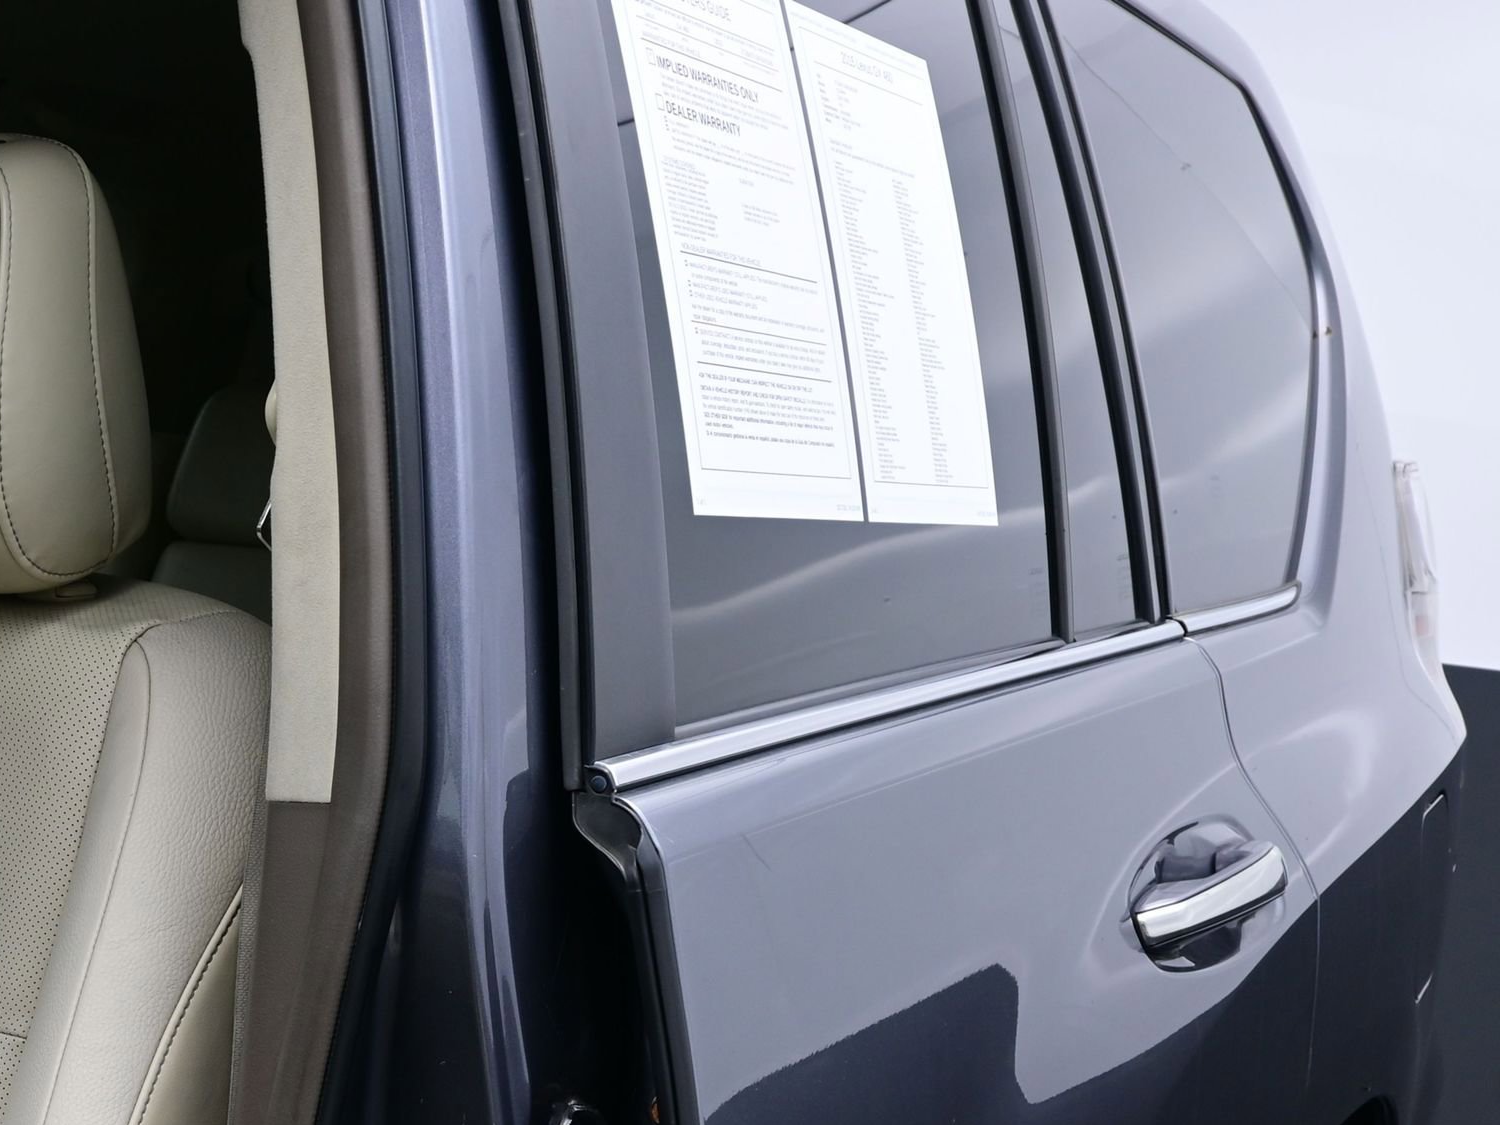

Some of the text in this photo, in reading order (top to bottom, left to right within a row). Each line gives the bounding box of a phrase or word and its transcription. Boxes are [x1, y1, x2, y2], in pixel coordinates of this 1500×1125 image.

[656, 56, 759, 103] IMPLIED WARRANTIES ONLY
[665, 101, 741, 136] DEALER WARRANTY
